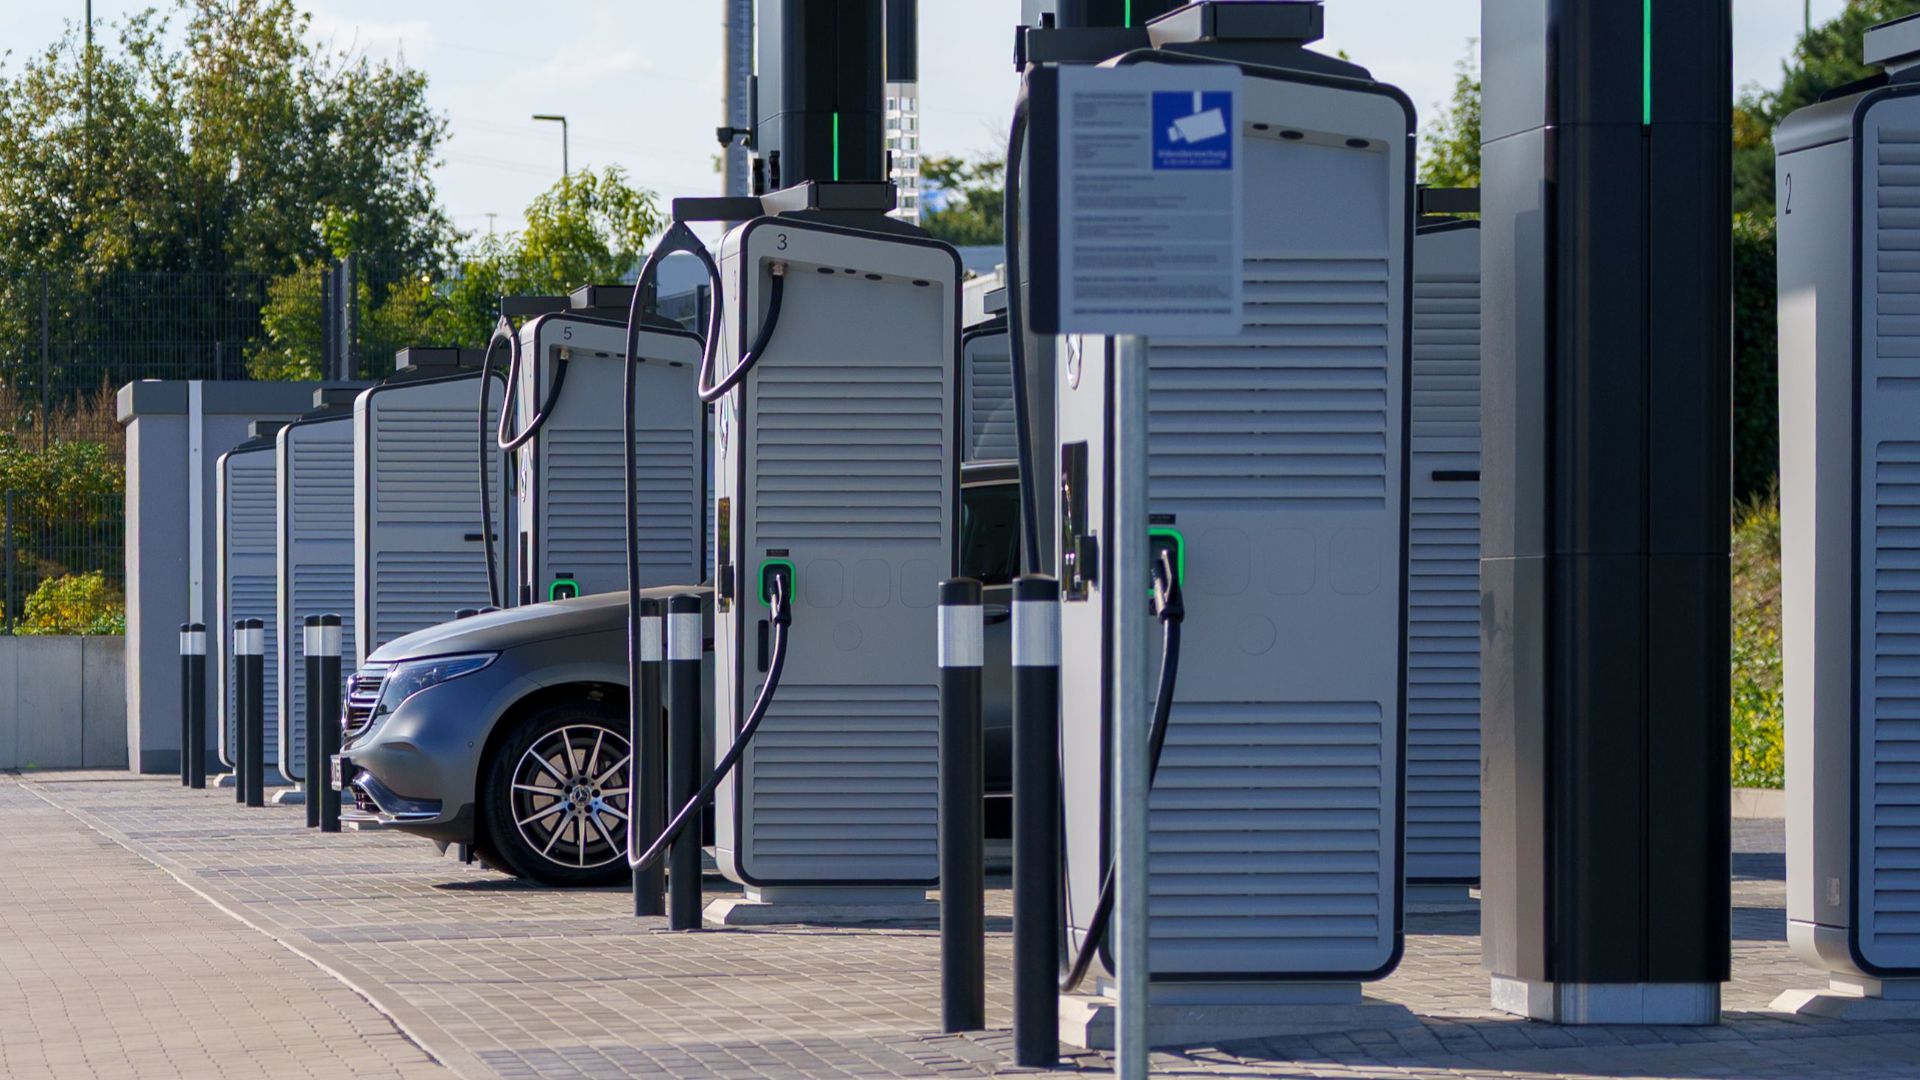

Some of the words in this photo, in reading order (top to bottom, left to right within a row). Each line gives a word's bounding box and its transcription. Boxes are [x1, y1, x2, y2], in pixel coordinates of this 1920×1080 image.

[1785, 172, 1792, 215] 2
[776, 233, 788, 250] 3
[563, 326, 572, 340] 5
